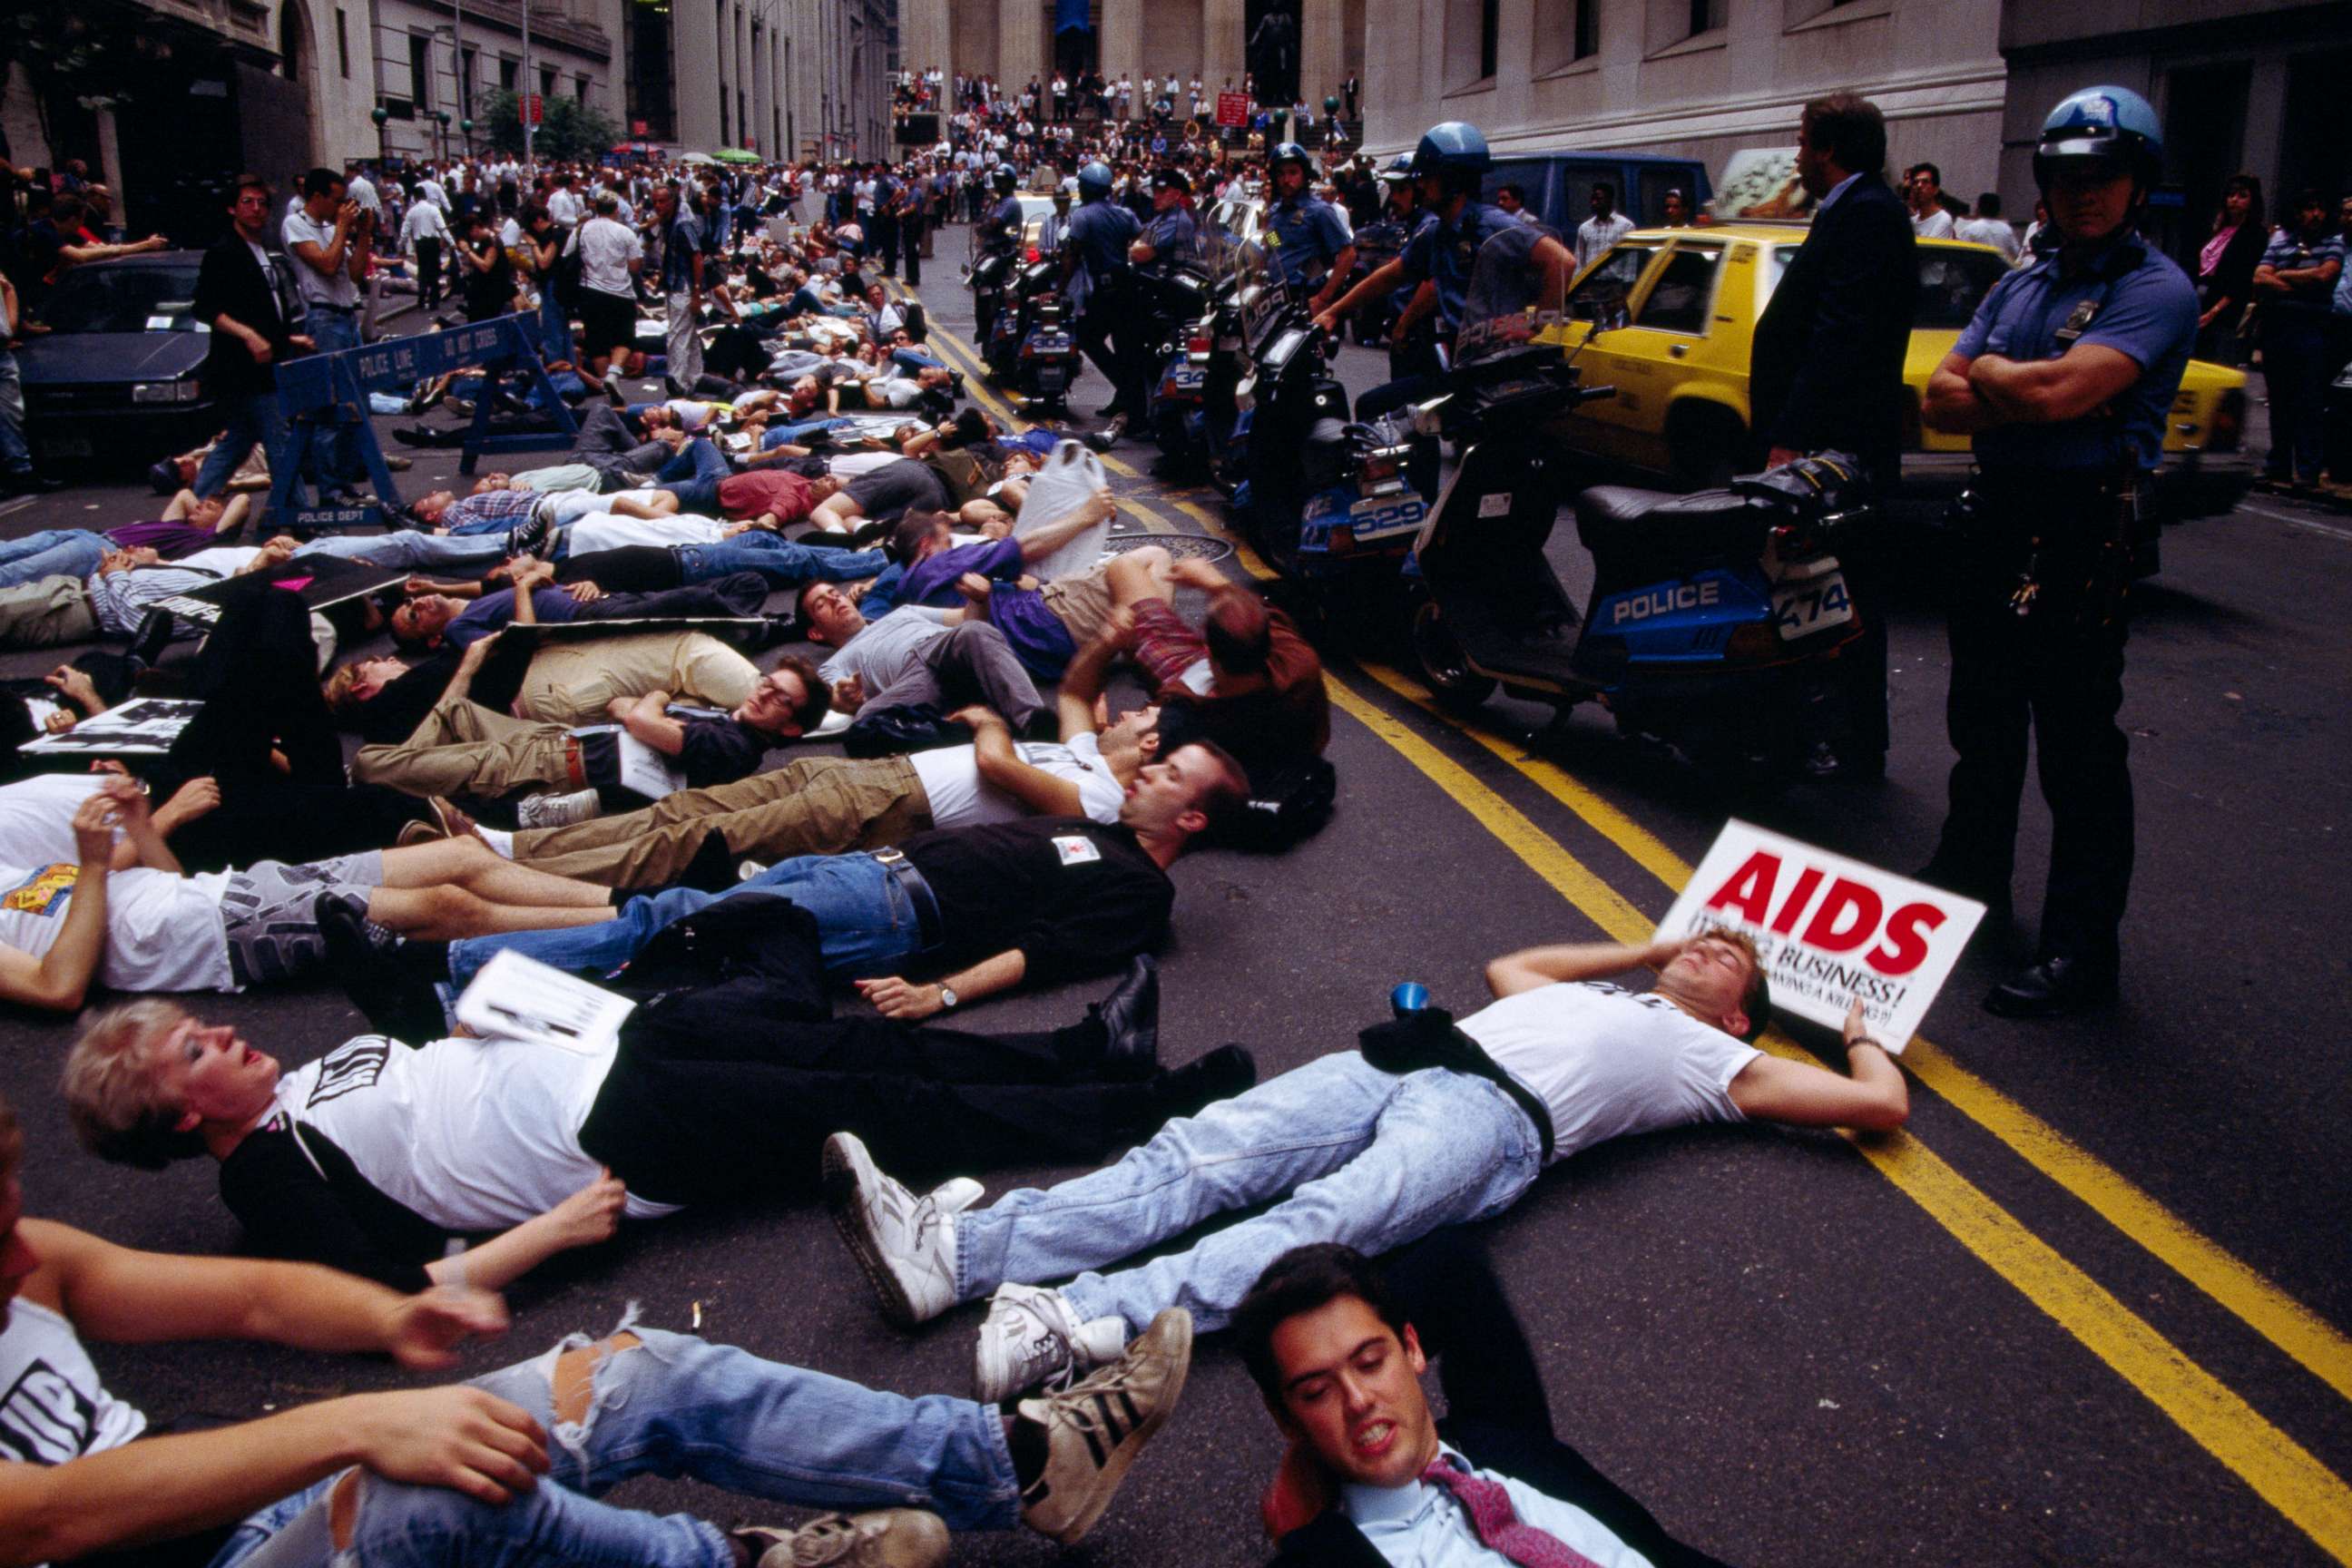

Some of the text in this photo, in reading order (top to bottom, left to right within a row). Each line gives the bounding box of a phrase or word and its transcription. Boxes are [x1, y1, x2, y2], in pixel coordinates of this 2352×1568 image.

[358, 353, 389, 377] POLICE
[394, 348, 413, 369] LINE
[457, 333, 471, 353] NOT
[475, 328, 498, 349] CROSS
[298, 510, 364, 523] POLICE DEPT
[1351, 501, 1424, 534] 529
[1613, 581, 1720, 624] POLICE
[1776, 583, 1850, 627] 474
[1706, 851, 1947, 975] AIDS
[1778, 945, 1906, 1008] BUSINESS!
